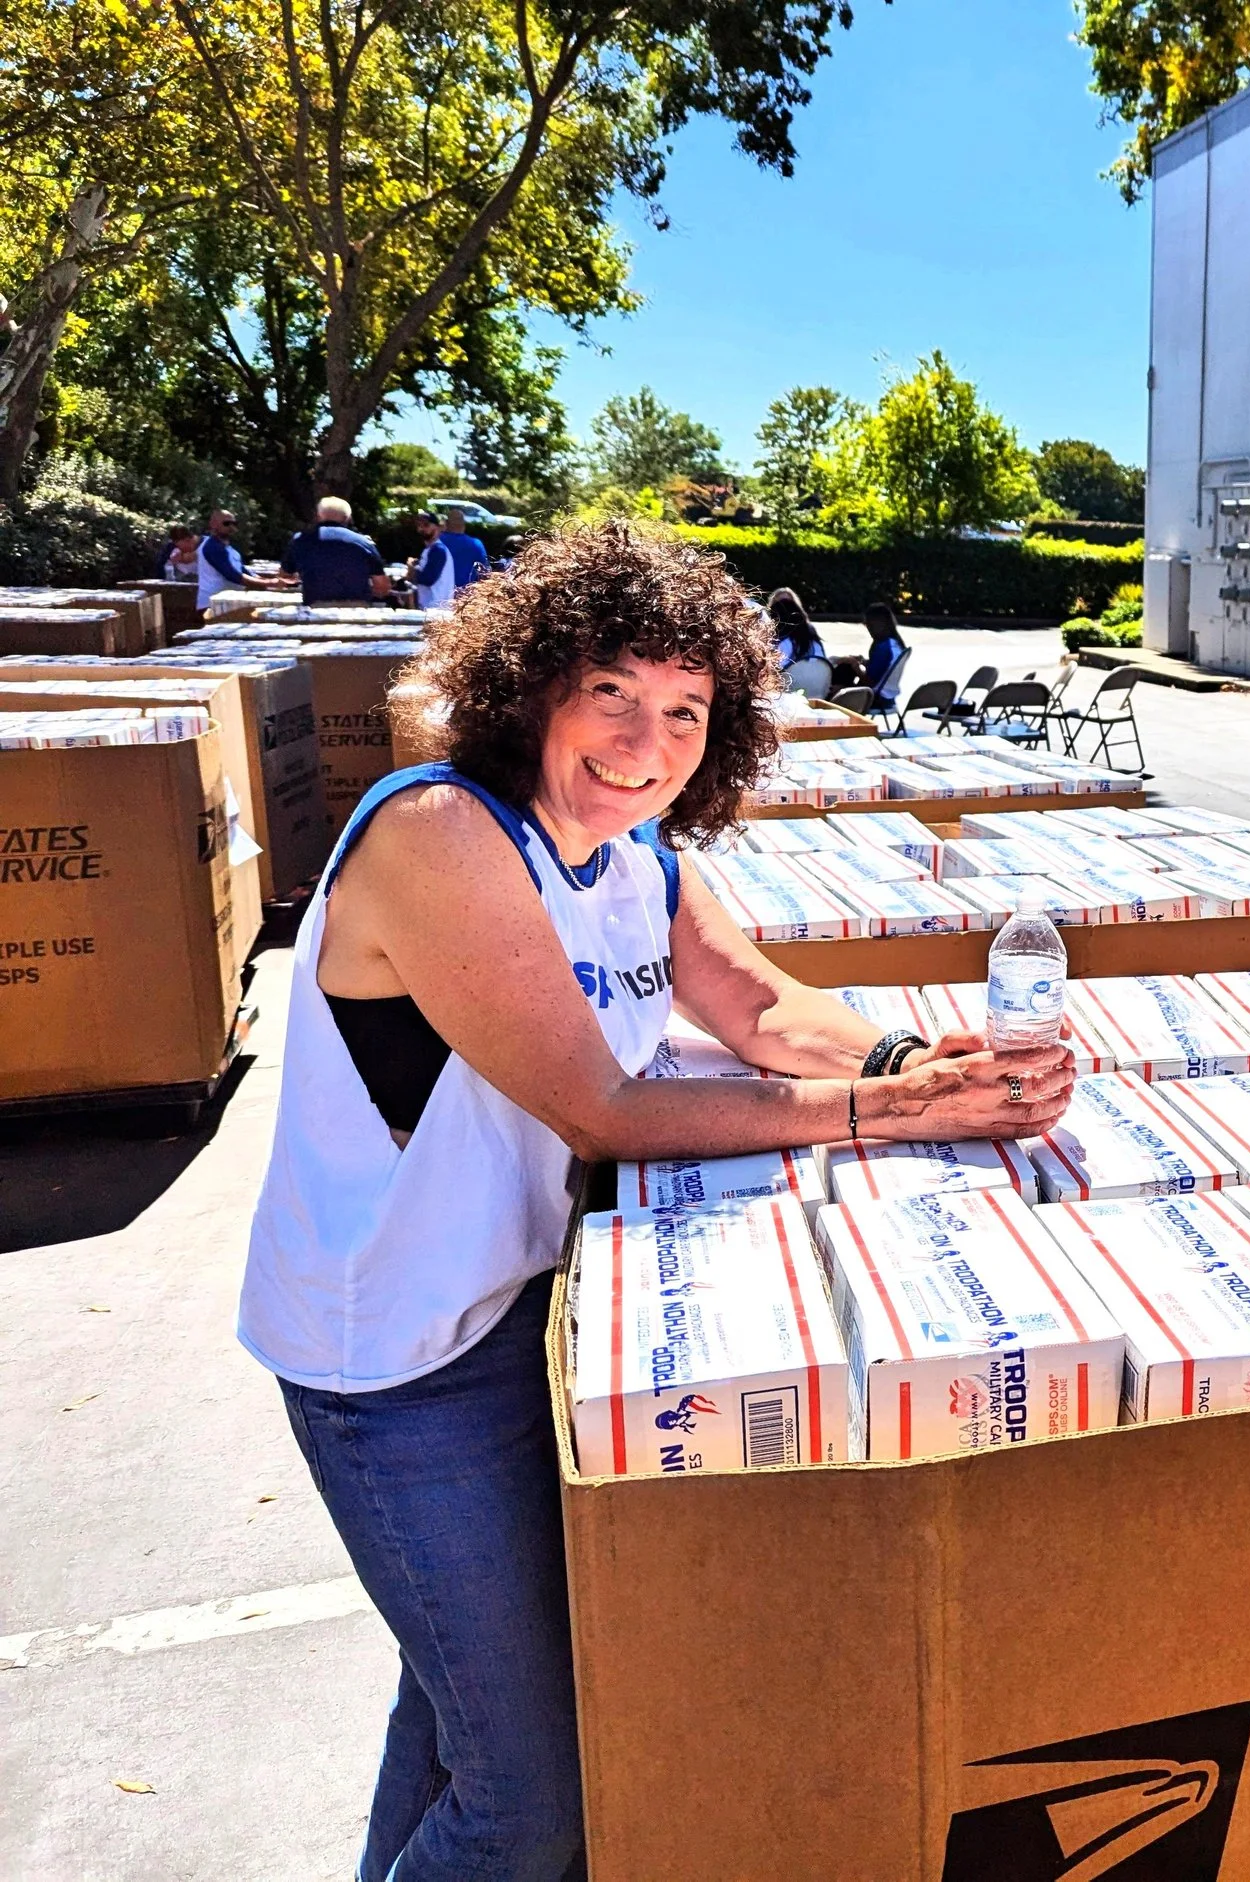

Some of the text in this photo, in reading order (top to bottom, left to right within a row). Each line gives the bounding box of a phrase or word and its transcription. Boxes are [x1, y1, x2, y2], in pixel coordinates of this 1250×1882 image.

[319, 732, 391, 747] SERVICE
[0, 825, 89, 853] ATES
[53, 937, 95, 956] USE
[0, 967, 40, 985] SPS
[653, 1219, 681, 1285] TROOPATHON
[1159, 1204, 1220, 1258] TROOPATHON
[947, 1259, 1009, 1327] TROOPATHON
[651, 1346, 678, 1398] TROOP
[989, 1361, 1003, 1420] MILITARY
[1003, 1347, 1028, 1443] TROOP
[689, 1453, 702, 1470] ES
